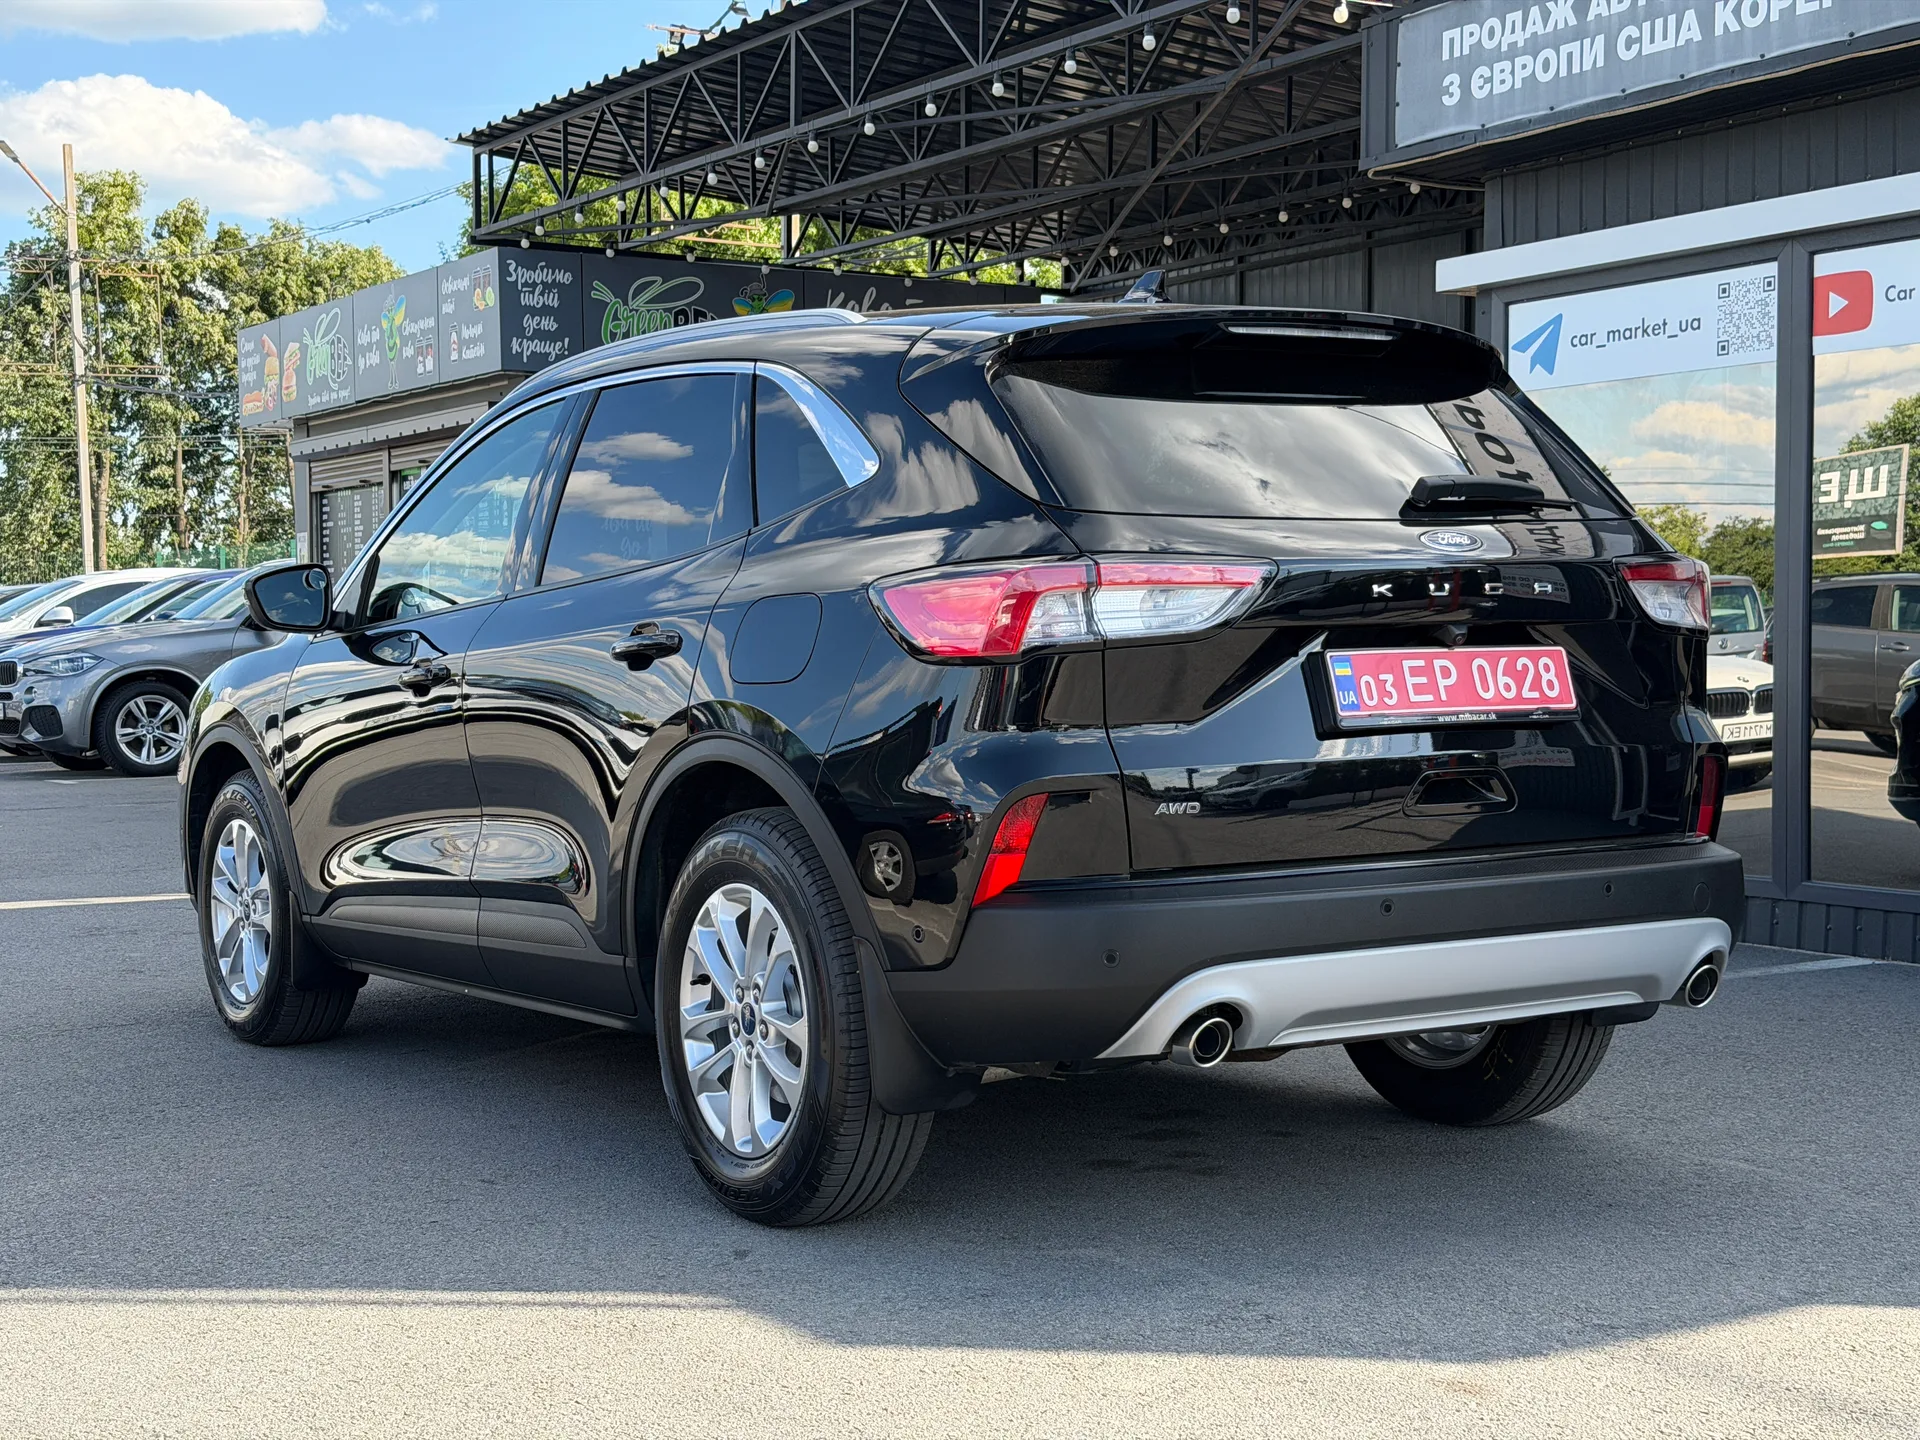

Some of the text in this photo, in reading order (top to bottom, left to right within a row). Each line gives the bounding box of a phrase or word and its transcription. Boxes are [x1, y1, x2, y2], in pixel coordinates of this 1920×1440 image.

[1442, 0, 1578, 61] ПРОДАЖ
[1441, 73, 1461, 106] З
[1471, 34, 1605, 99] ЄВРОПИ
[1617, 9, 1702, 61] США
[506, 260, 573, 290] Зробимо
[520, 285, 561, 308] твій
[1885, 285, 1915, 302] Car
[523, 314, 559, 336] день
[1570, 316, 1701, 349] car_market_ua
[511, 337, 570, 363] краще!
[1438, 532, 1471, 544] Ford
[1339, 656, 1560, 707] UA 03 EP 0628
[1154, 802, 1201, 815] AWD
